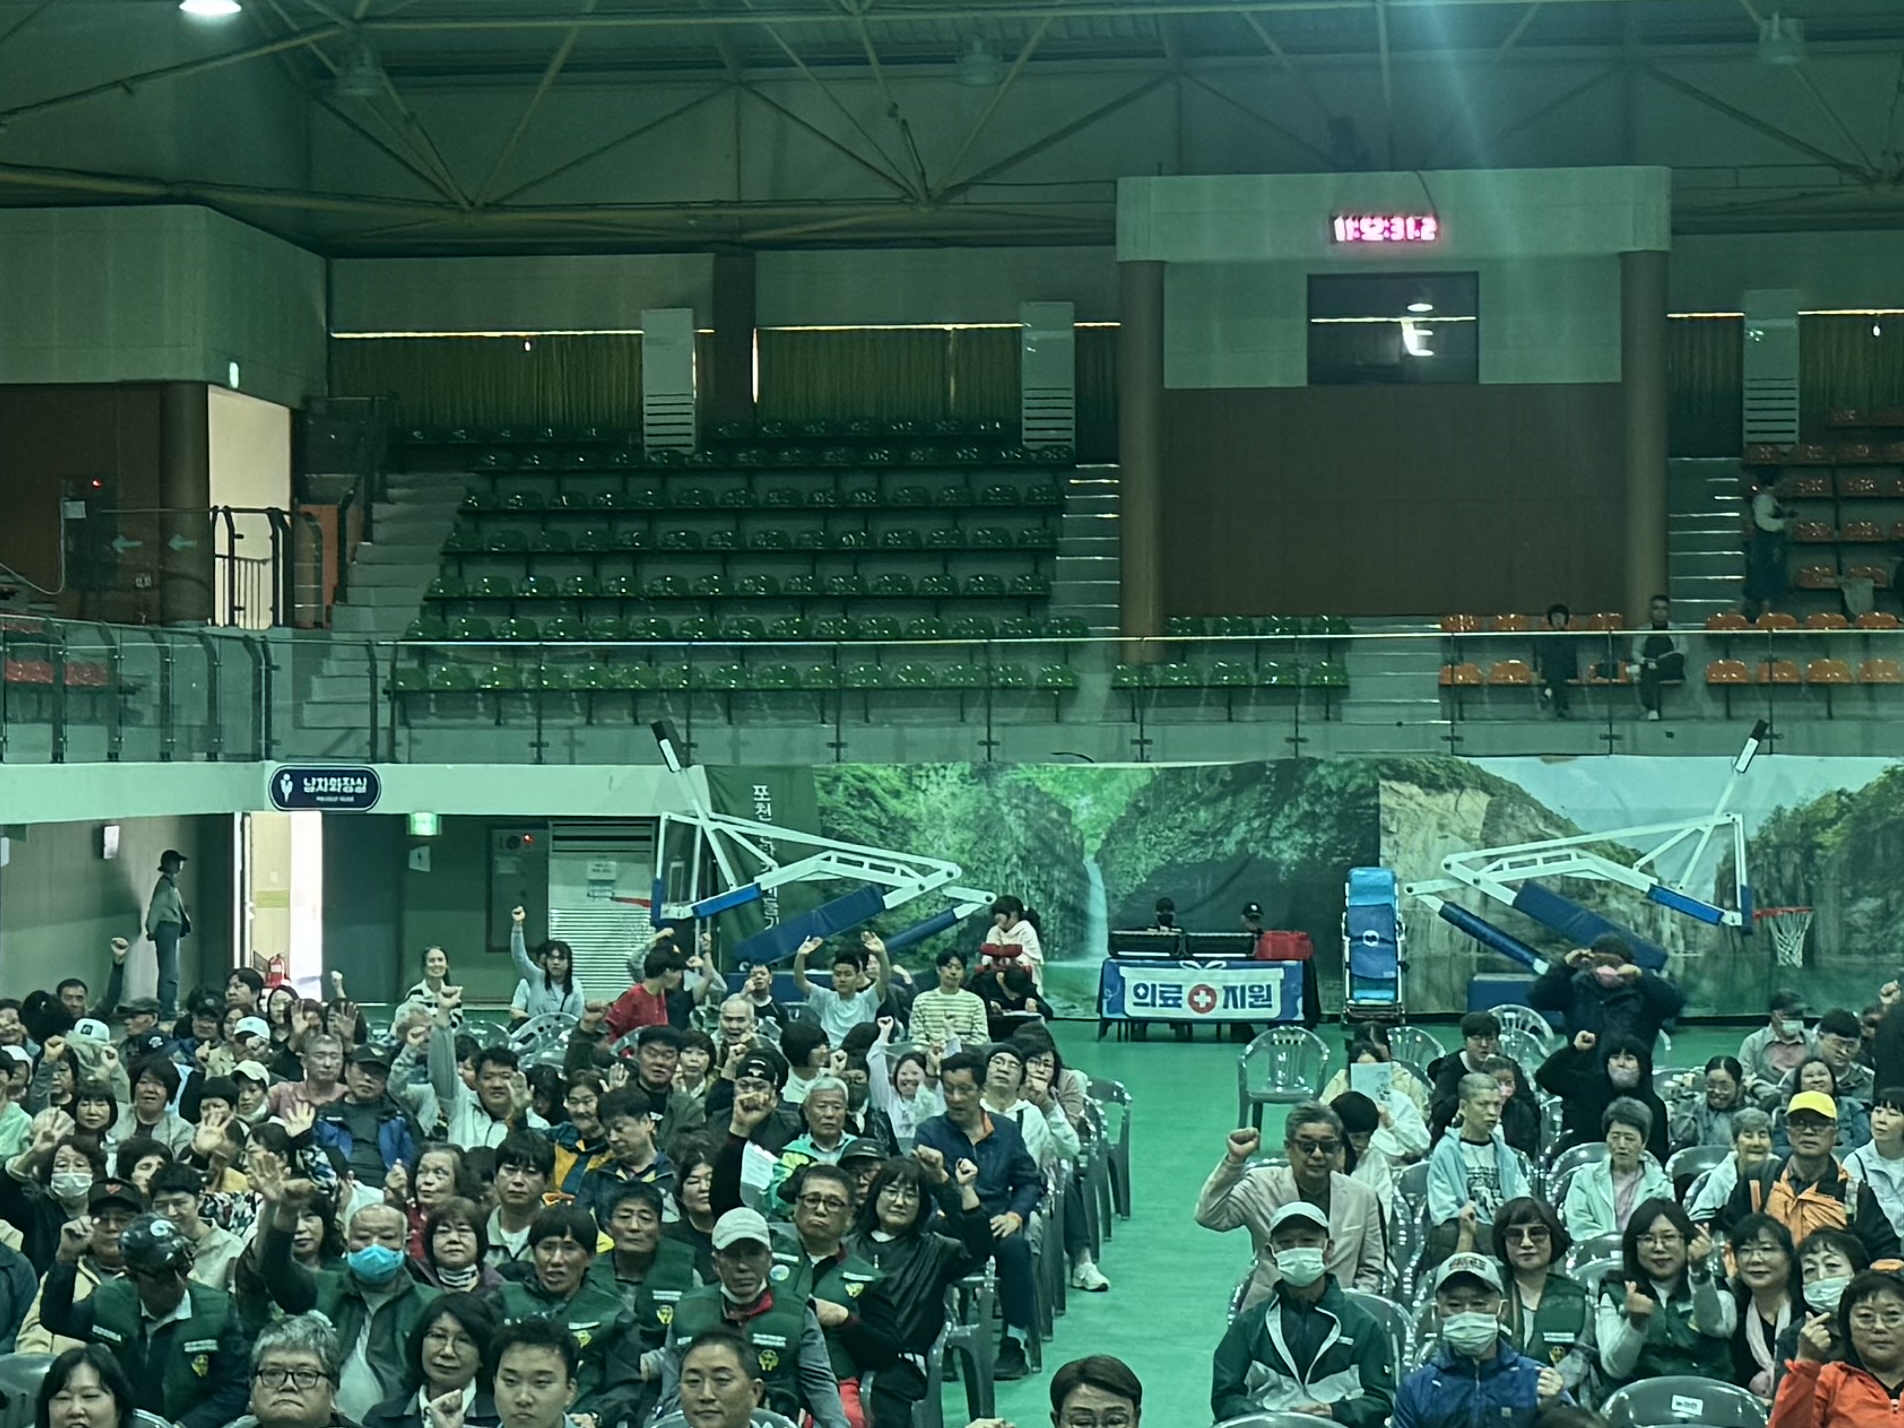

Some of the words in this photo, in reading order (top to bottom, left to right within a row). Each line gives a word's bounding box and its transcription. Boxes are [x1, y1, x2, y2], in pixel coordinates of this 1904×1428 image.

[303, 776, 368, 794] 남자화장실
[752, 784, 772, 821] 포천
[1132, 982, 1183, 1008] 의료
[1222, 984, 1273, 1009] 지원
